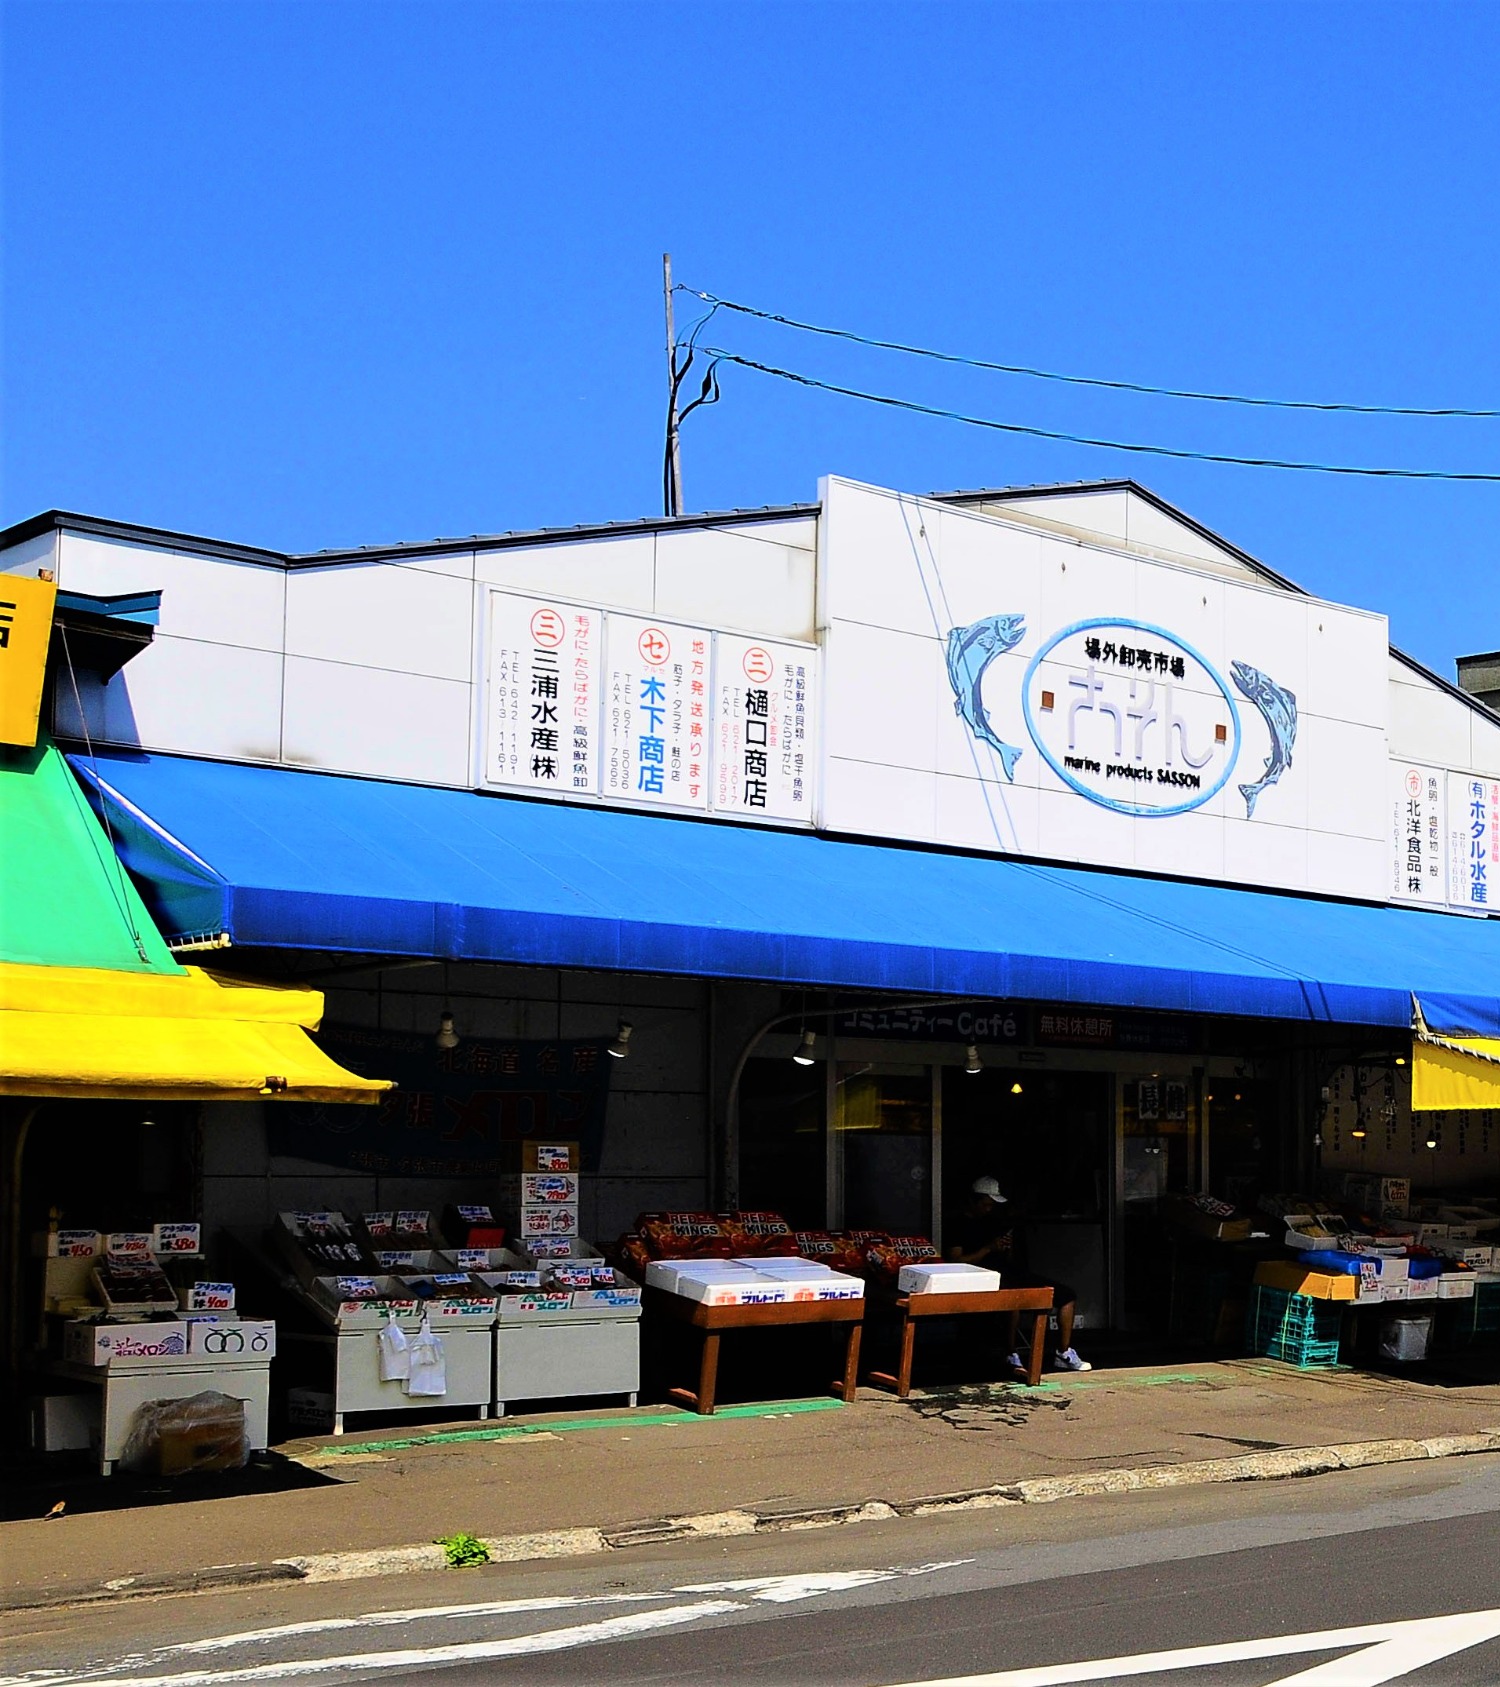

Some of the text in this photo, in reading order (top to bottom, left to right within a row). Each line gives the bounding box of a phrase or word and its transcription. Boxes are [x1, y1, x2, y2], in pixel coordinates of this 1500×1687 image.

[1085, 636, 1185, 679] 場外卸売市場
[689, 639, 704, 798] 地方発送承ります
[638, 676, 666, 795] 木下商店
[743, 687, 770, 809] 樋口商店
[1064, 754, 1201, 790] marine products SASSON
[843, 1009, 1018, 1038] コミュニティー Café
[1040, 1015, 1113, 1038] 無料休憩所
[669, 1212, 700, 1225] RED
[739, 1212, 767, 1224] RED
[745, 1223, 788, 1235] KINGS
[674, 1224, 719, 1236] KINGS
[891, 1237, 916, 1248] RED
[897, 1246, 936, 1257] KINGS
